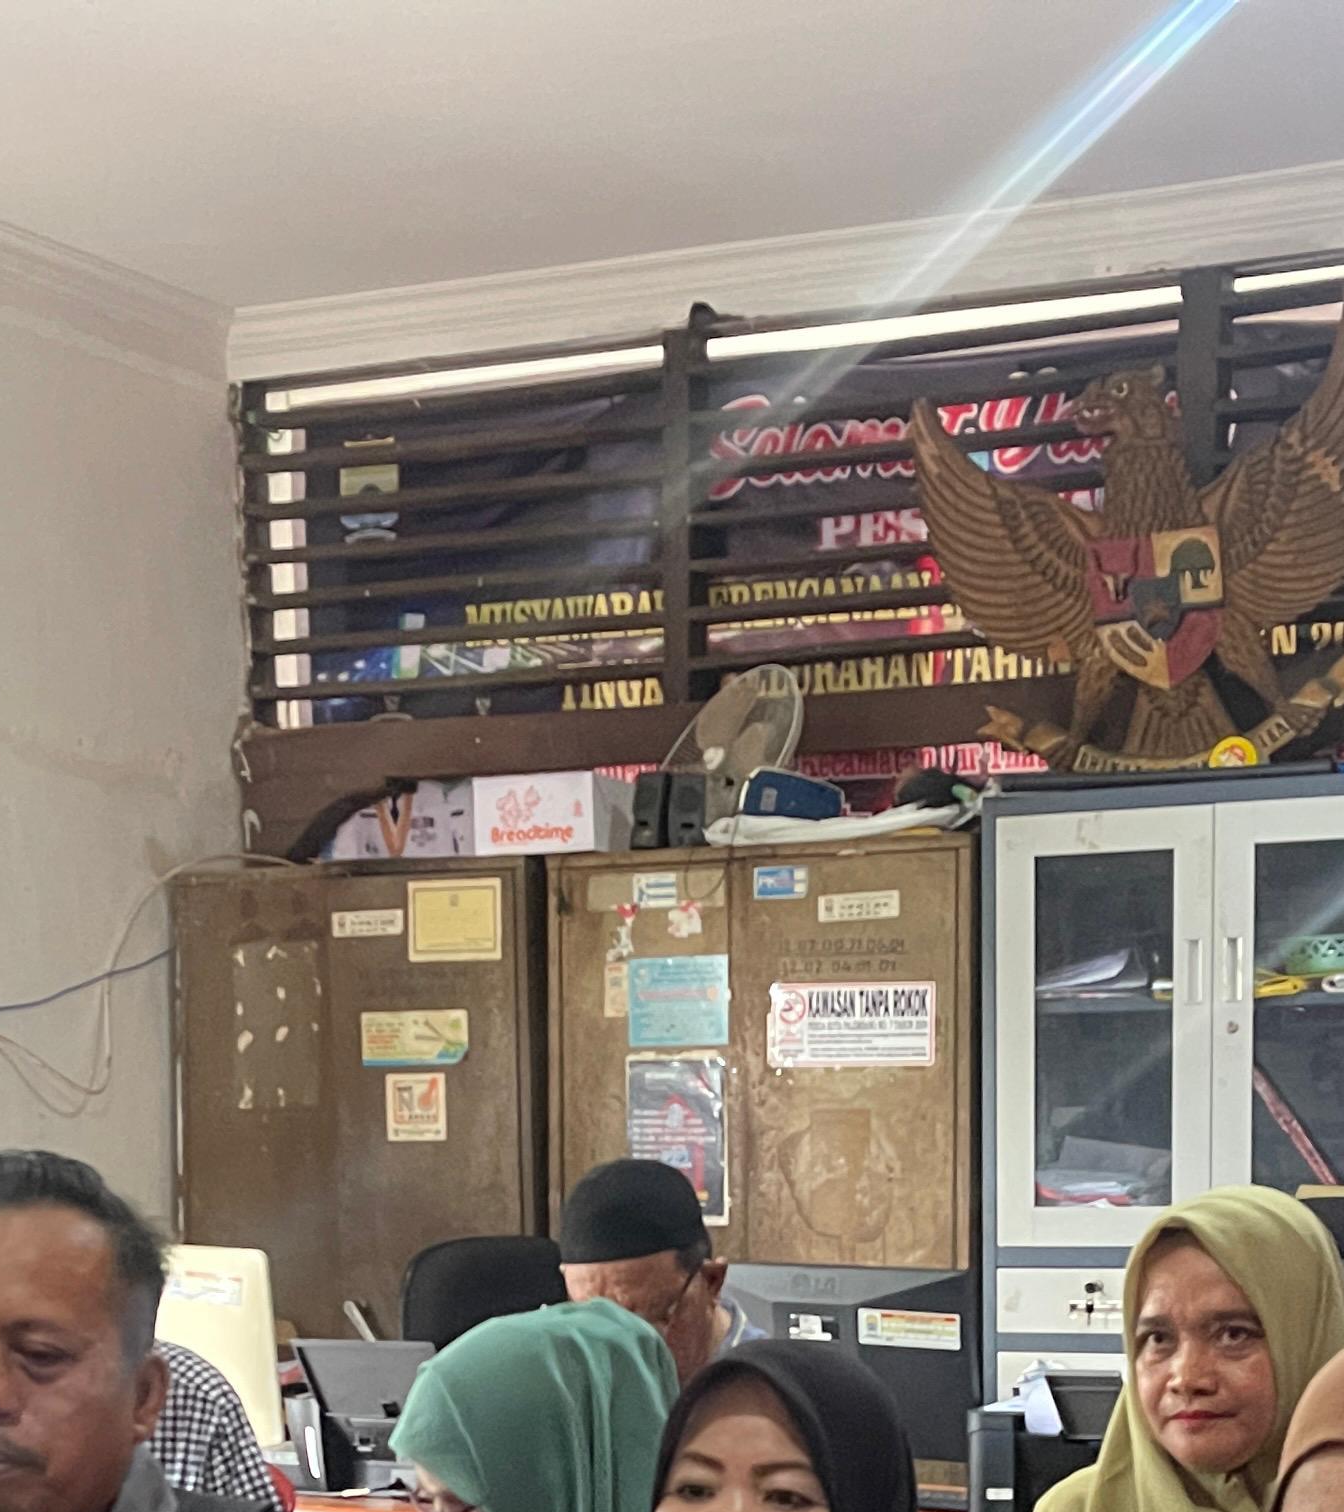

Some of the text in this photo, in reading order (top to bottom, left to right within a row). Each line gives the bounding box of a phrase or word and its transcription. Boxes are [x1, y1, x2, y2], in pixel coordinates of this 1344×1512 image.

[807, 987, 929, 1018] KAWASAN TANPA ROKOK
